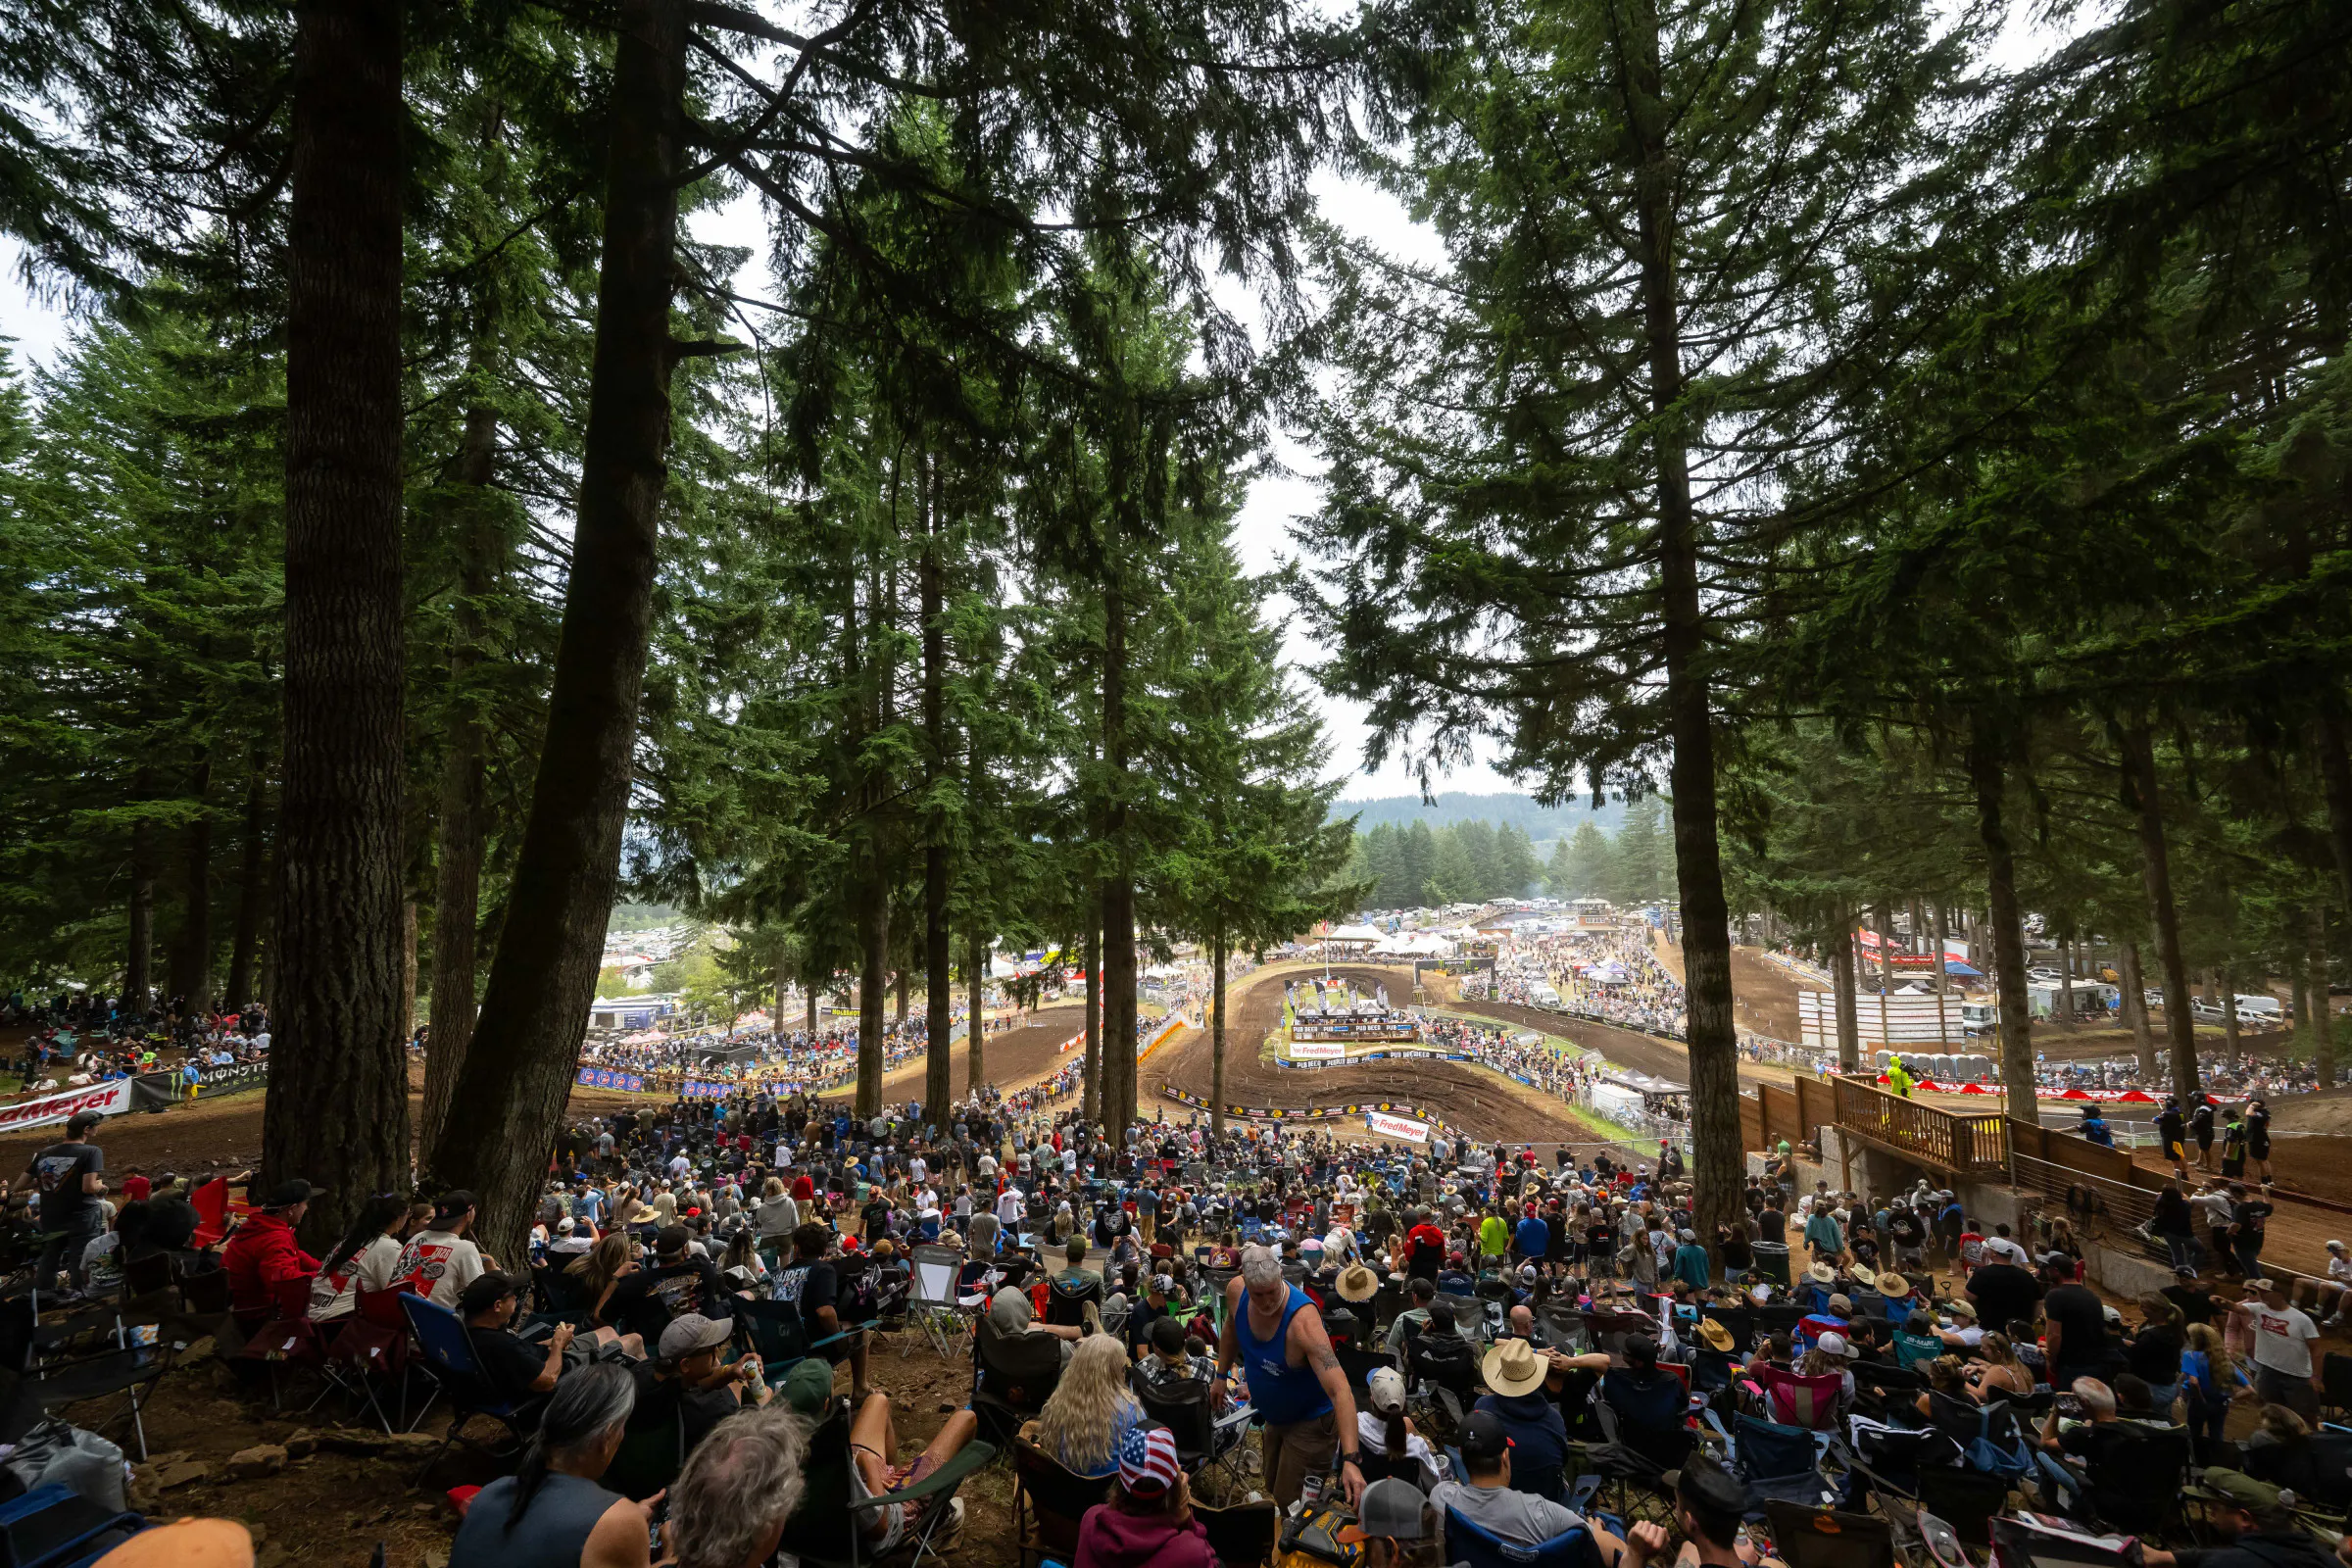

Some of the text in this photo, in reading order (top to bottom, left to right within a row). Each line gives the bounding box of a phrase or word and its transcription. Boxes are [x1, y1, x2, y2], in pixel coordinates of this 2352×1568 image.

[199, 1061, 269, 1083] MONSTE
[1379, 1119, 1425, 1137] FredMeyer
[433, 1247, 450, 1259] 2026
